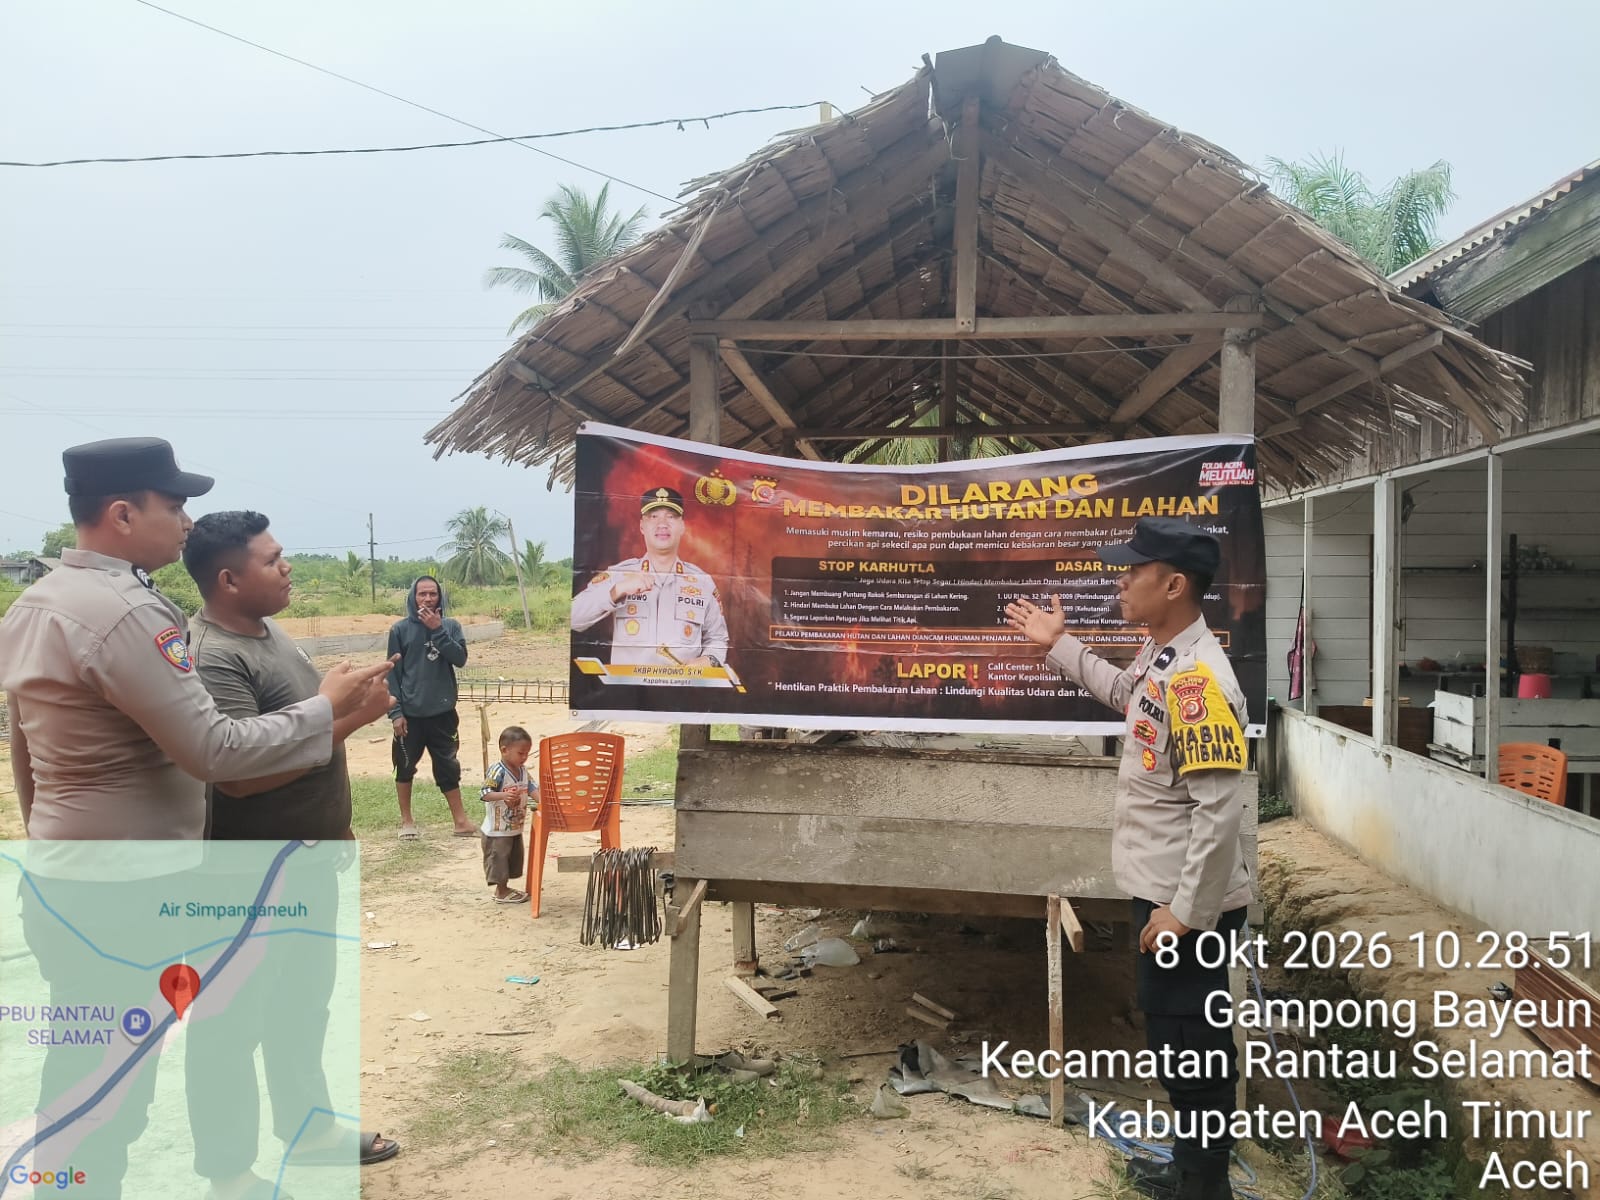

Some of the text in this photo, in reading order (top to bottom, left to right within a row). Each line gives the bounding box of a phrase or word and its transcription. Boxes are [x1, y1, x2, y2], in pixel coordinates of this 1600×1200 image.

[1224, 461, 1243, 469] ACEH
[900, 474, 1099, 506] DILARANG
[783, 495, 1219, 520] MEMBAKAR HUTAN DAN LAHAN
[786, 526, 829, 536] Memasuki
[831, 529, 860, 538] musim
[862, 529, 901, 539] kemarau,
[903, 529, 929, 538] resiko
[931, 530, 982, 539] pembukaan
[984, 530, 1008, 539] lahan
[1010, 530, 1042, 541] dengan
[1063, 528, 1107, 538] membakar
[1110, 527, 1133, 536] (Land
[828, 540, 864, 548] percikan
[866, 541, 880, 549] api
[881, 541, 910, 549] sekecil
[930, 543, 947, 551] pun
[948, 541, 974, 551] dapat
[975, 541, 1010, 549] memicu
[1011, 540, 1055, 549] kebakaran
[1057, 539, 1080, 548] besar
[1081, 541, 1103, 549] yang
[1104, 538, 1122, 547] sulit
[818, 560, 936, 573] STOP KARHUTLA
[1055, 560, 1103, 572] DASAR
[790, 589, 810, 598] Jangan
[842, 591, 867, 599] Puntung
[886, 591, 923, 600] Sembarangan
[931, 592, 948, 600] Lahan
[677, 596, 704, 607] POLRI
[790, 601, 811, 609] Hindari
[857, 603, 879, 611] Dengan
[879, 603, 893, 611] Cara
[790, 614, 809, 622] Segera
[835, 615, 858, 623] Petugas
[1080, 617, 1100, 625] Pidana
[800, 631, 846, 639] PEMBAKARAN
[847, 632, 870, 640] HUTAN
[1112, 635, 1137, 643] DENDA
[633, 667, 652, 675] AKBP
[897, 662, 967, 680] LAPOR
[987, 663, 1004, 671] Call
[1018, 674, 1062, 682] Kepolisian
[774, 682, 816, 692] Hentikan
[818, 683, 850, 693] Praktik
[852, 684, 908, 694] Pembakaran
[910, 685, 937, 695] Lahan
[945, 686, 985, 697] Lindungi
[988, 687, 1025, 696] Kualitas
[1027, 687, 1055, 697] Udara
[1057, 687, 1076, 697] dan
[1138, 695, 1164, 723] POLRI
